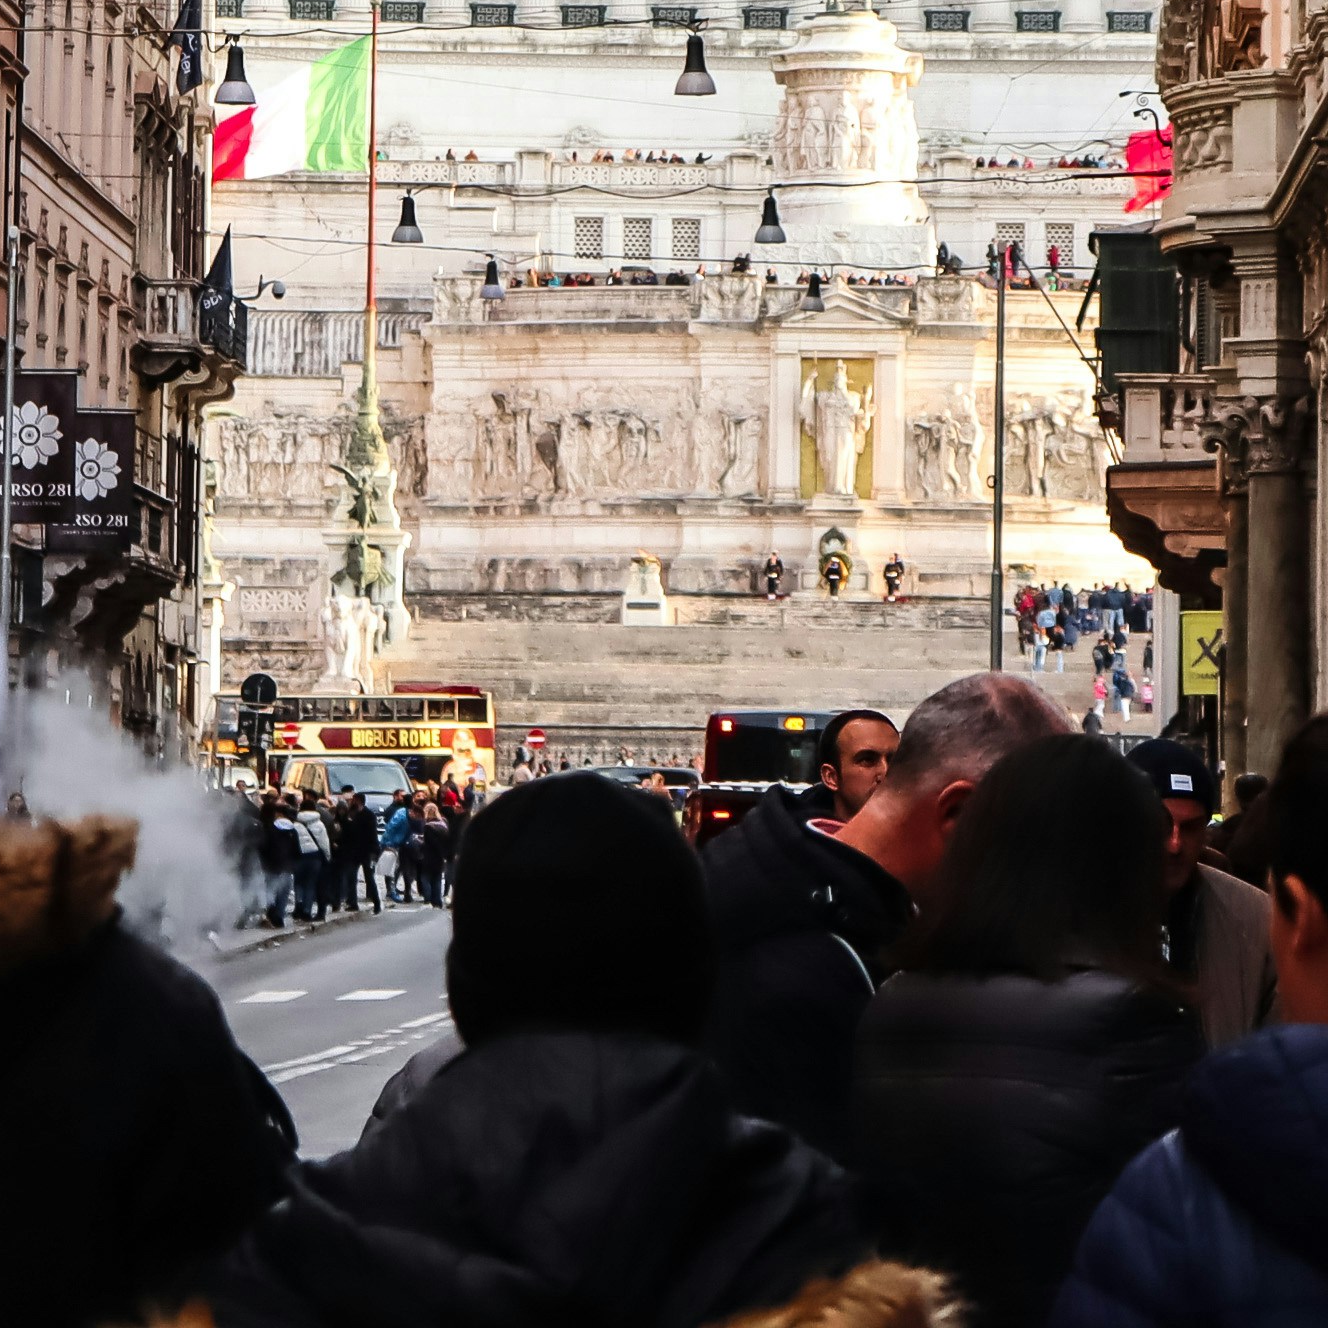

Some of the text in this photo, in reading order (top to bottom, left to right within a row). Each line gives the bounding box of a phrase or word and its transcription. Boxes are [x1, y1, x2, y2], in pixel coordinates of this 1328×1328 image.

[48, 483, 71, 497] 281
[106, 514, 129, 527] 281
[399, 728, 441, 747] ROME
